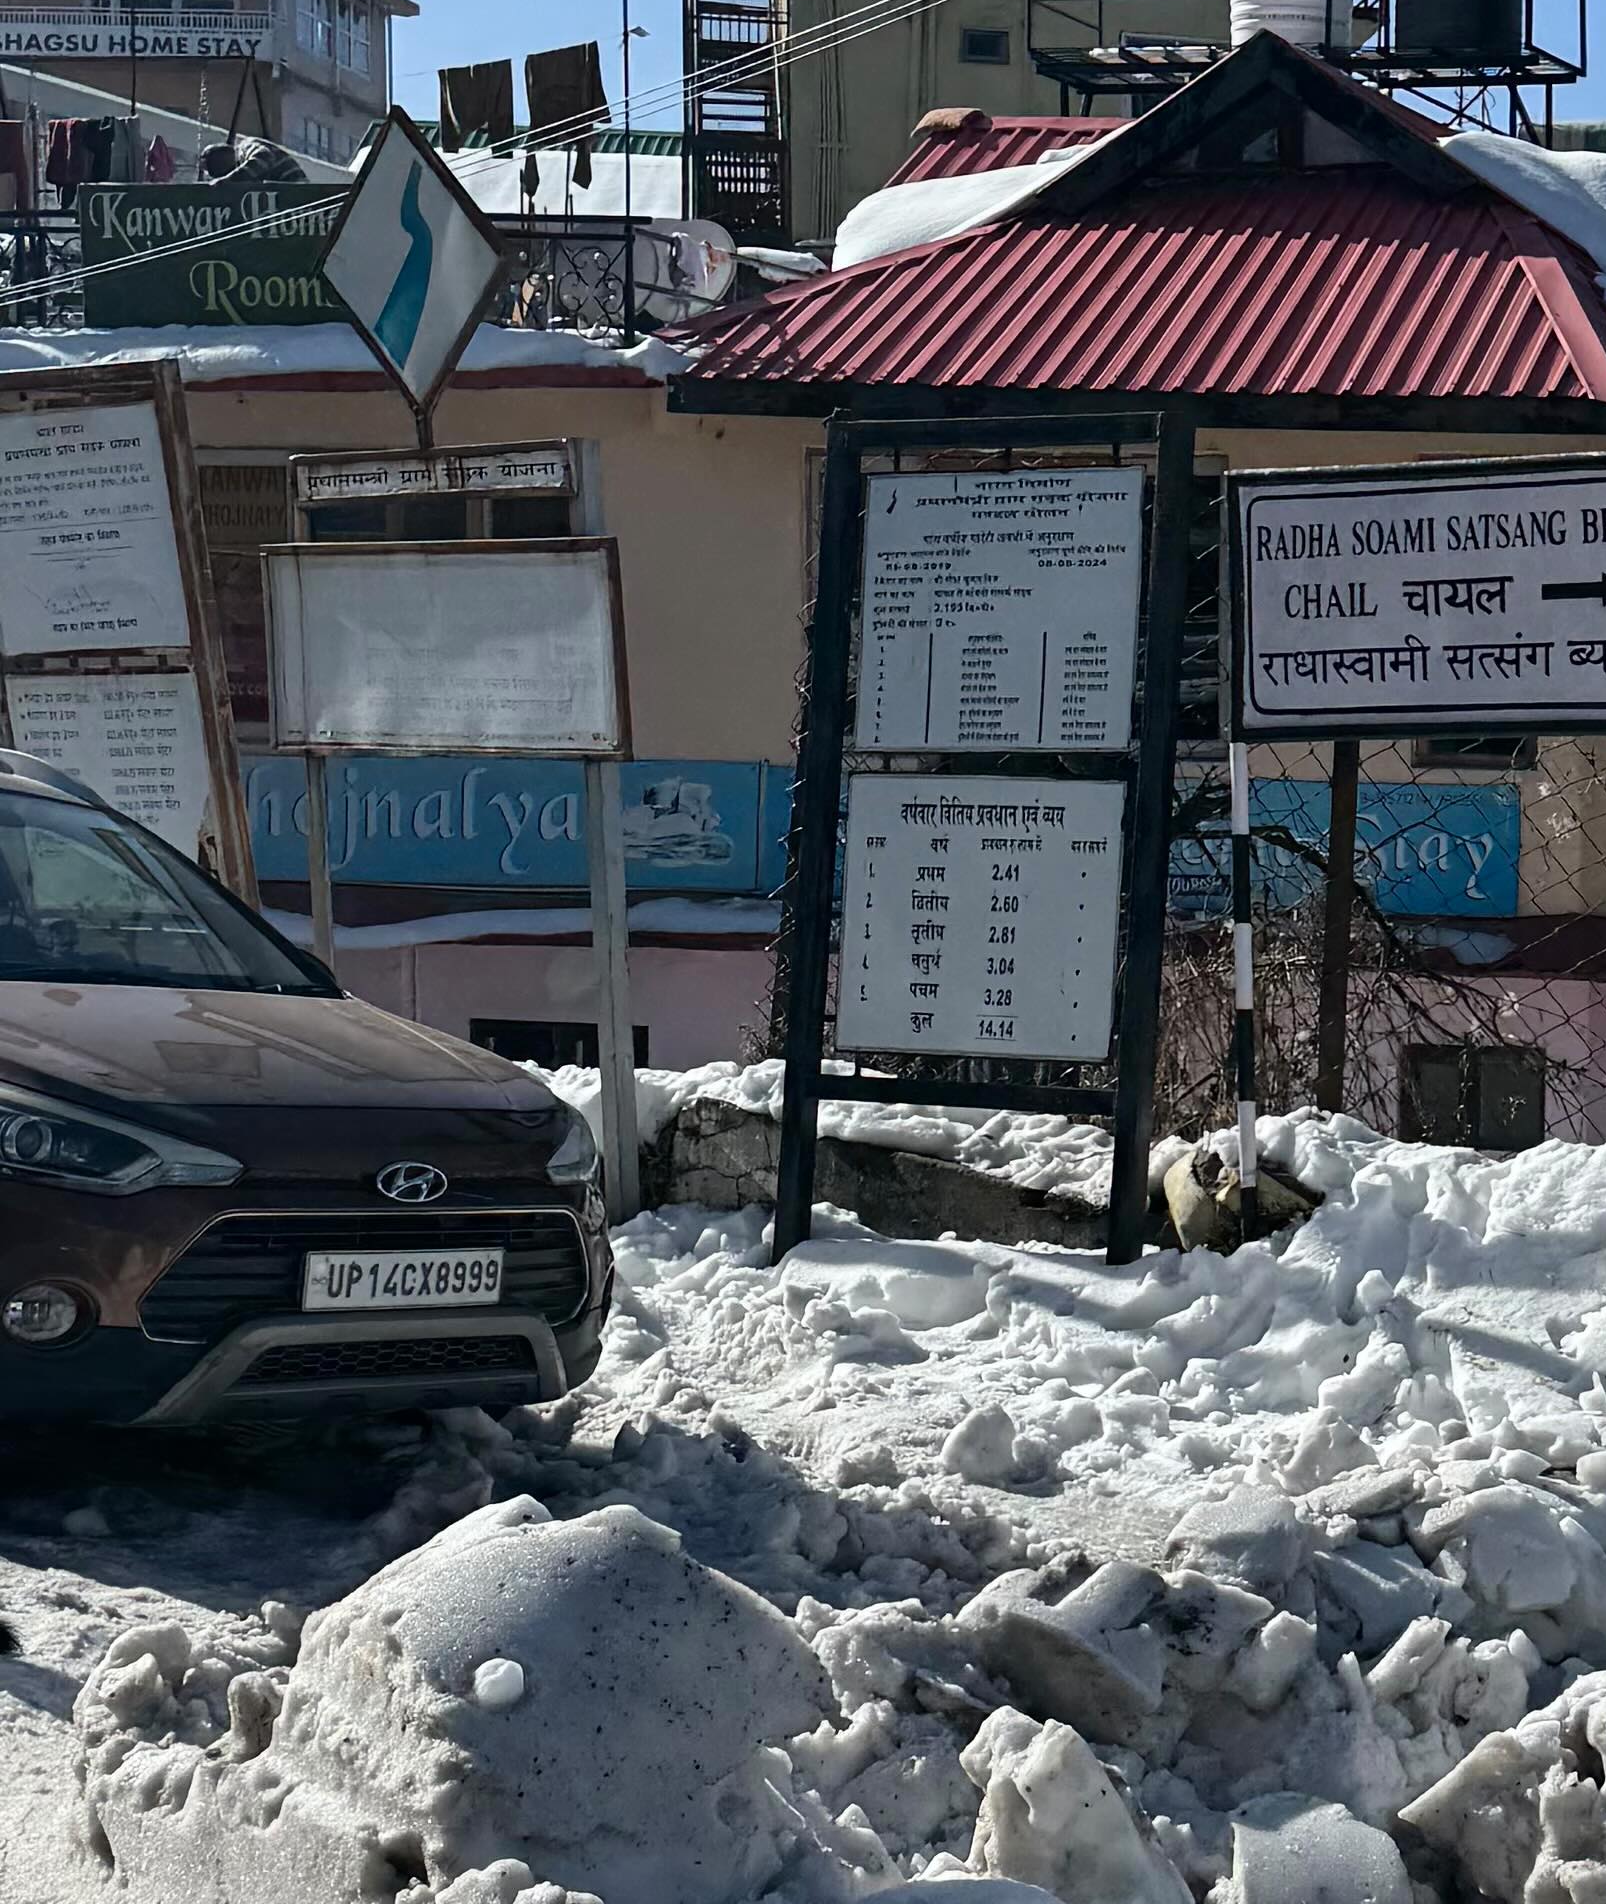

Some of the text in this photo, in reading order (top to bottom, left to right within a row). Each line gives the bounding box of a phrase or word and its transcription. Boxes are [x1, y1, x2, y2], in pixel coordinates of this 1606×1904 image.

[0, 32, 261, 57] HAGSU HOME STAY
[89, 191, 231, 253] Kanwar
[190, 260, 340, 325] Room
[1256, 522, 1342, 562] RADHA
[1351, 517, 1436, 556] SOAMI
[1446, 509, 1567, 551] SATSANG
[1284, 576, 1514, 620] CHAIL चायल
[1259, 633, 1431, 686] राधास्वामी
[1443, 631, 1554, 680] सत्संग
[991, 863, 1020, 882] 2.41
[912, 889, 950, 912] द्वितीय
[990, 895, 1019, 913] 2.60
[911, 919, 1017, 945] तृतीय 2.81
[986, 957, 1015, 975] 3.04
[983, 988, 1012, 1007] 3.28
[910, 1011, 1014, 1039] कुल 14.14
[327, 1259, 500, 1299] UP14CX8999
